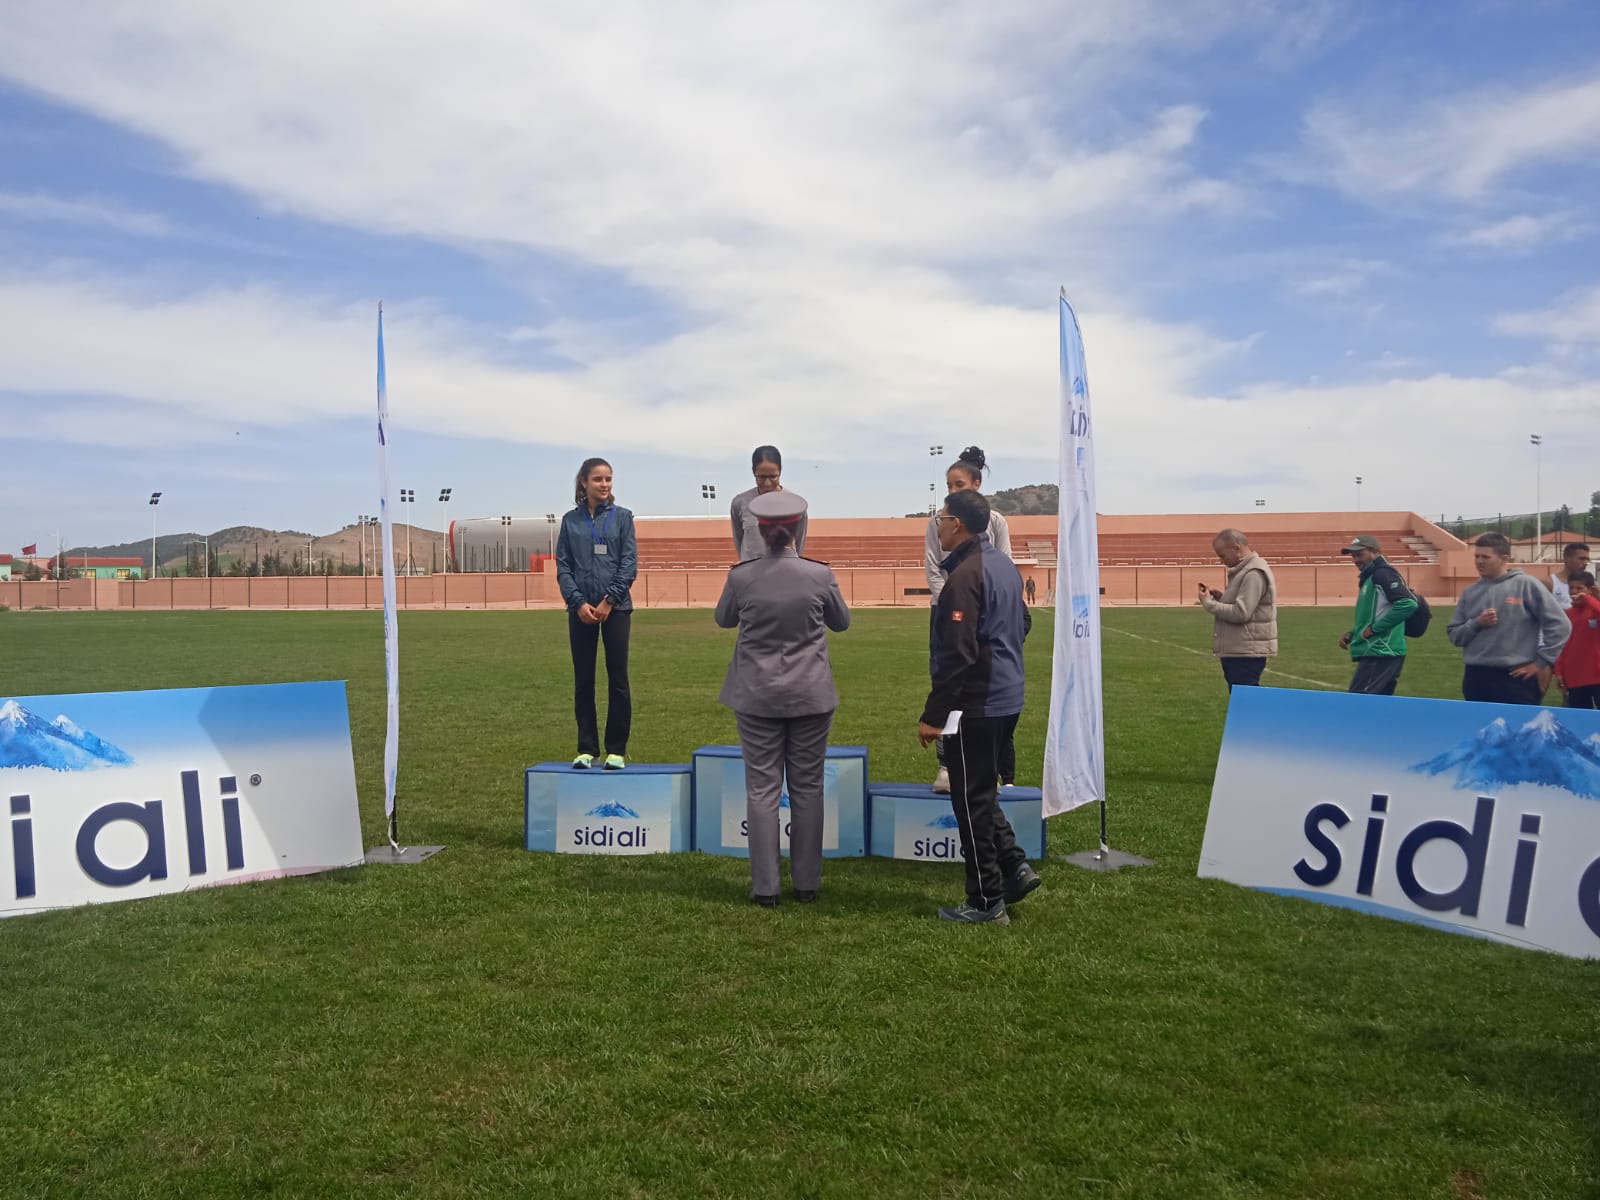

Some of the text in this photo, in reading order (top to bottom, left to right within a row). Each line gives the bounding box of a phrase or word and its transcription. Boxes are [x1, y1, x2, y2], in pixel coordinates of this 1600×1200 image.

[574, 825, 646, 847] sidi ali
[914, 836, 956, 859] sidi
[1292, 794, 1542, 927] sidi
